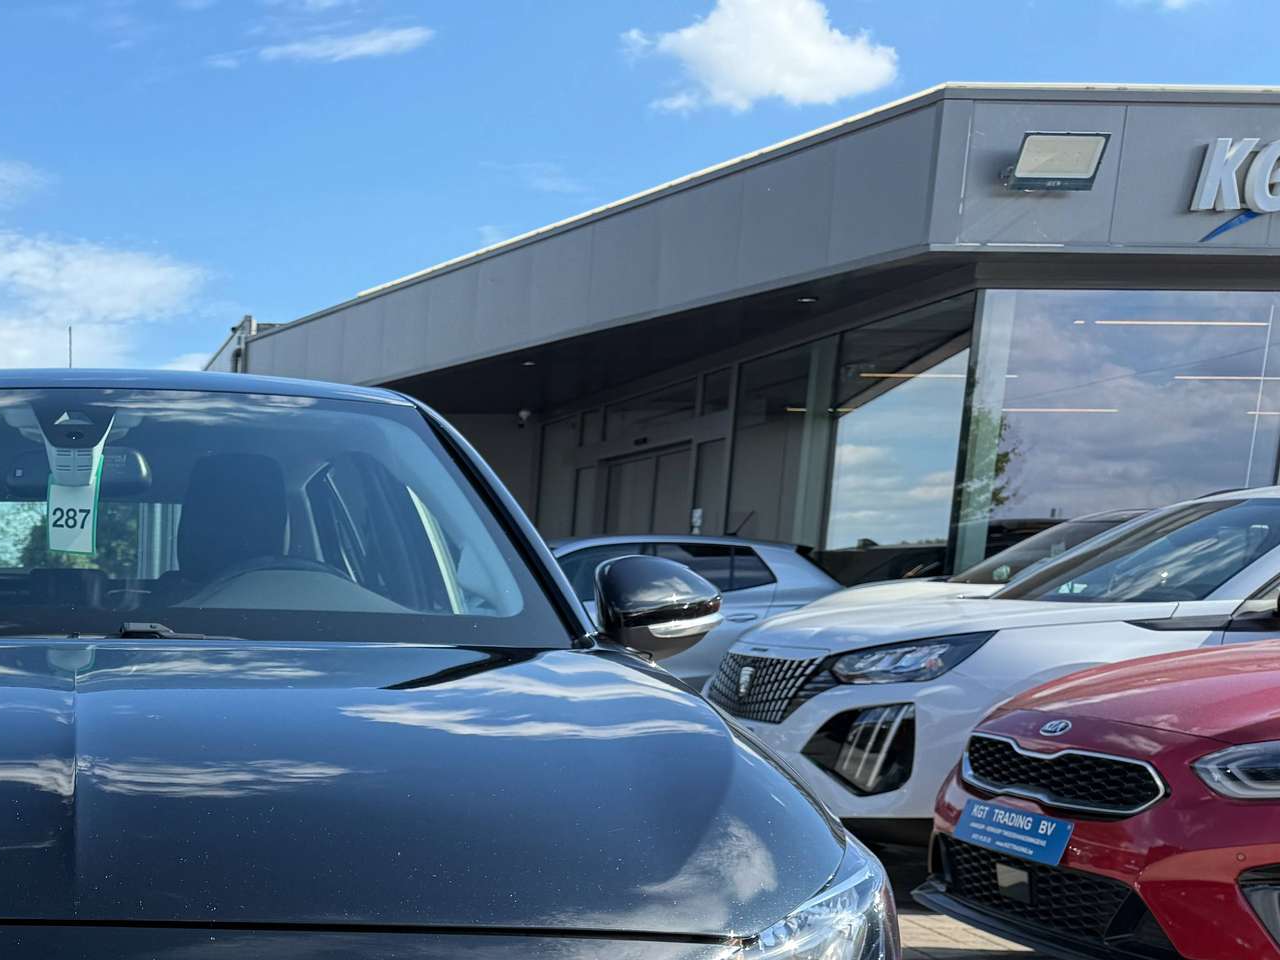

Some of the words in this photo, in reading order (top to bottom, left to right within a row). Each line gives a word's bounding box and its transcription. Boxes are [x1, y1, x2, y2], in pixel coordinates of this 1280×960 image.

[52, 507, 91, 530] 287
[971, 804, 989, 819] KGT
[992, 808, 1034, 831] TRADING
[1038, 820, 1057, 836] BV
